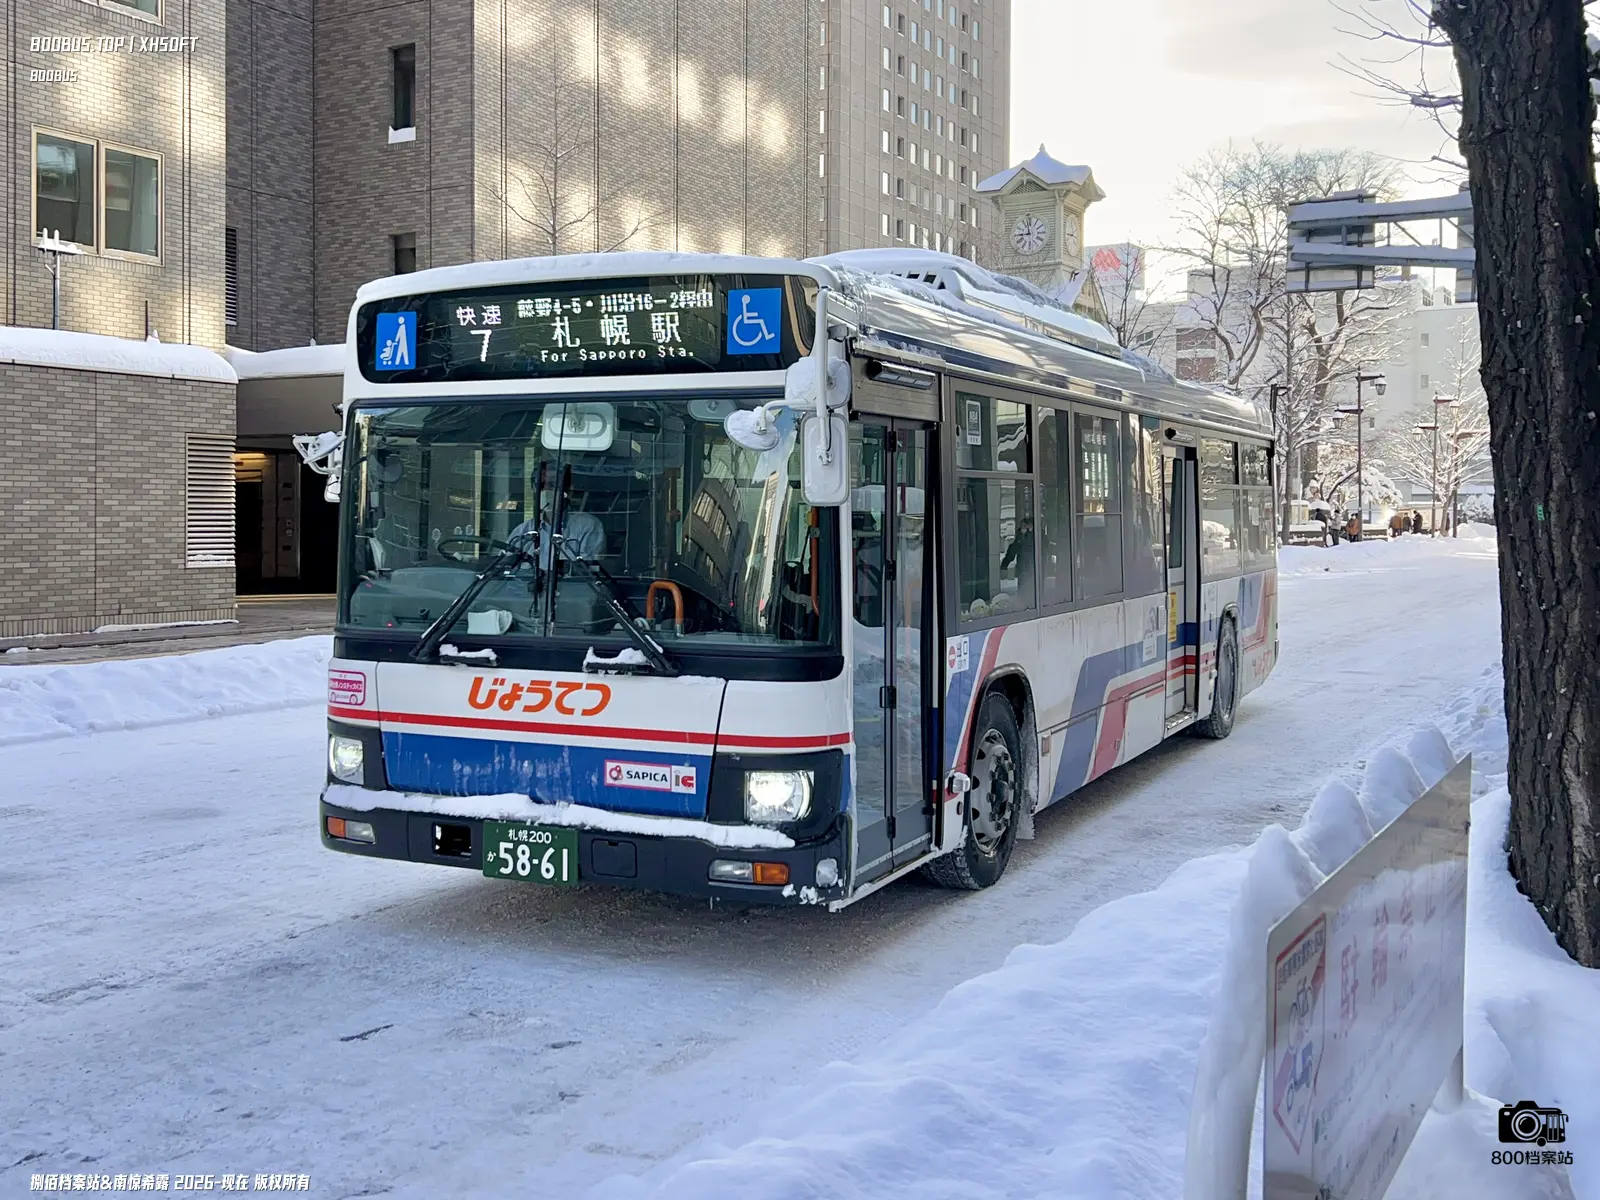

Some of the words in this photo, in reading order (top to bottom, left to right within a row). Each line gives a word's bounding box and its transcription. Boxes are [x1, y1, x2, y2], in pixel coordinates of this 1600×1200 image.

[455, 304, 502, 326] 快速
[550, 311, 682, 349] 札幌駅
[469, 328, 493, 362] 7
[540, 350, 569, 363] For
[579, 348, 647, 362] Sapporo
[657, 344, 694, 358] Sta.
[467, 676, 612, 717] じょうてつ
[625, 770, 669, 783] SAPICA
[507, 827, 552, 844] 札幌200
[486, 851, 497, 862] か
[499, 841, 569, 882] 58-61
